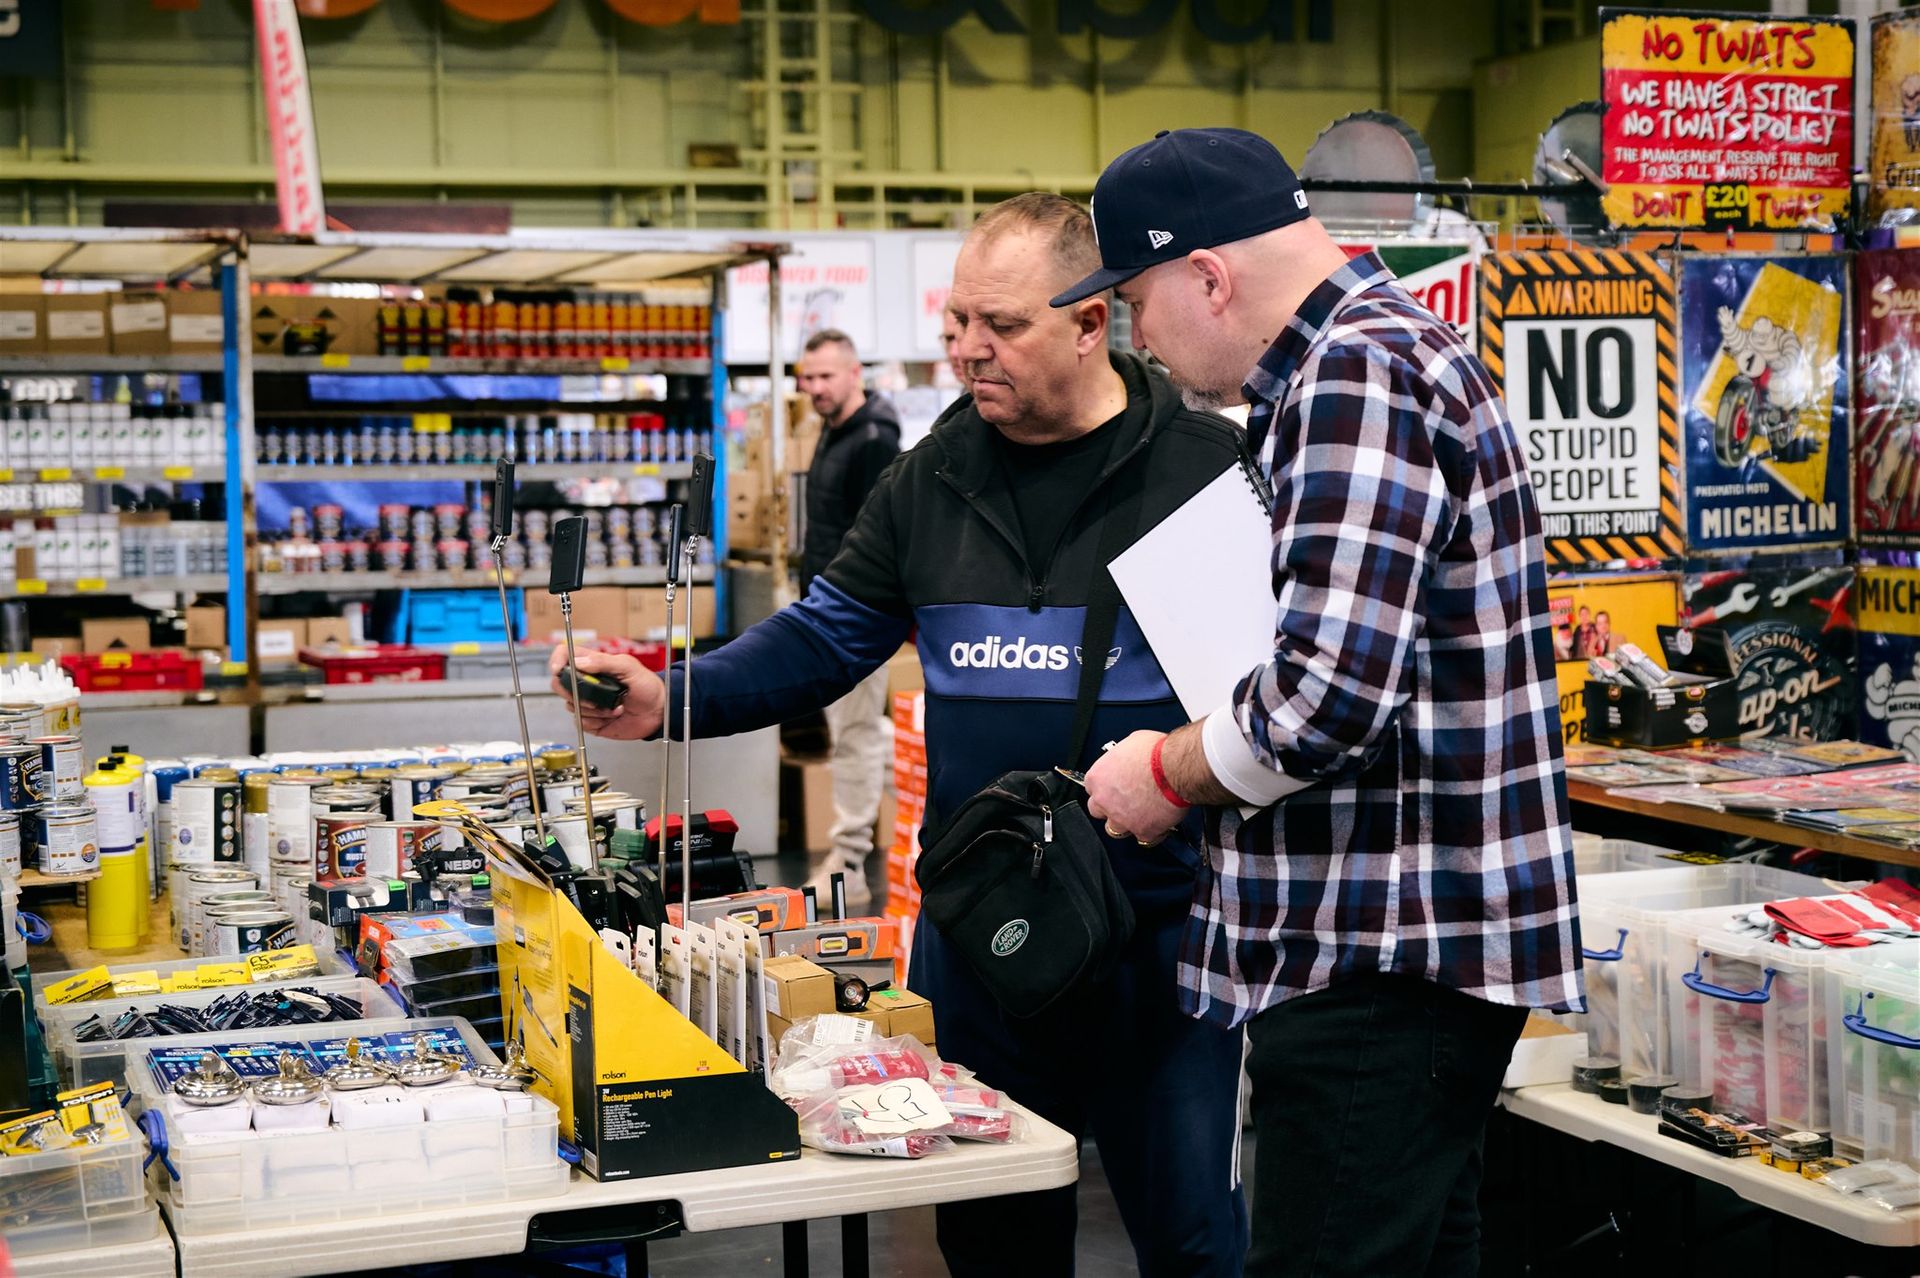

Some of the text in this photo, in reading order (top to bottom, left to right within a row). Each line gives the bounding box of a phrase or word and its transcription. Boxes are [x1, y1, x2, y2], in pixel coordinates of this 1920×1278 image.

[1693, 23, 1816, 69] TWATS
[1622, 80, 1839, 113] WE HAVE A STRICT
[1658, 109, 1750, 141] TWATS
[1751, 112, 1837, 145] POLICY
[1614, 147, 1839, 168] THE MANAGEMENT RESERVE THE RIGHT
[1660, 164, 1684, 180] ASK
[1685, 164, 1711, 180] ALL
[1778, 166, 1817, 182] LEAVE
[1705, 185, 1749, 208] £20
[1755, 191, 1825, 222] TWAT
[1713, 210, 1742, 219] each
[1413, 262, 1472, 326] ol
[1534, 279, 1655, 316] WARNING
[1871, 275, 1920, 318] Sna
[1527, 326, 1636, 420] NO
[1745, 354, 1756, 371] 1
[1528, 426, 1637, 461] STUPID
[1530, 467, 1640, 501] PEOPLE
[1747, 482, 1769, 495] MOTO
[1542, 511, 1660, 538] OND THIS POINT
[1701, 502, 1837, 540] MICHELIN
[1860, 577, 1920, 613] MICH
[950, 636, 1069, 671] adidas
[1733, 632, 1820, 665] FESSIONAL
[1738, 669, 1841, 728] ap-on
[1889, 701, 1920, 713] MICH
[338, 829, 367, 846] HAMM
[445, 858, 481, 871] NEBO
[997, 928, 1013, 946] LAND
[1003, 929, 1024, 950] ROVER
[602, 1072, 627, 1080] rolson
[63, 1089, 114, 1108] rolson
[602, 1089, 673, 1103] Rechargeable Pen Light
